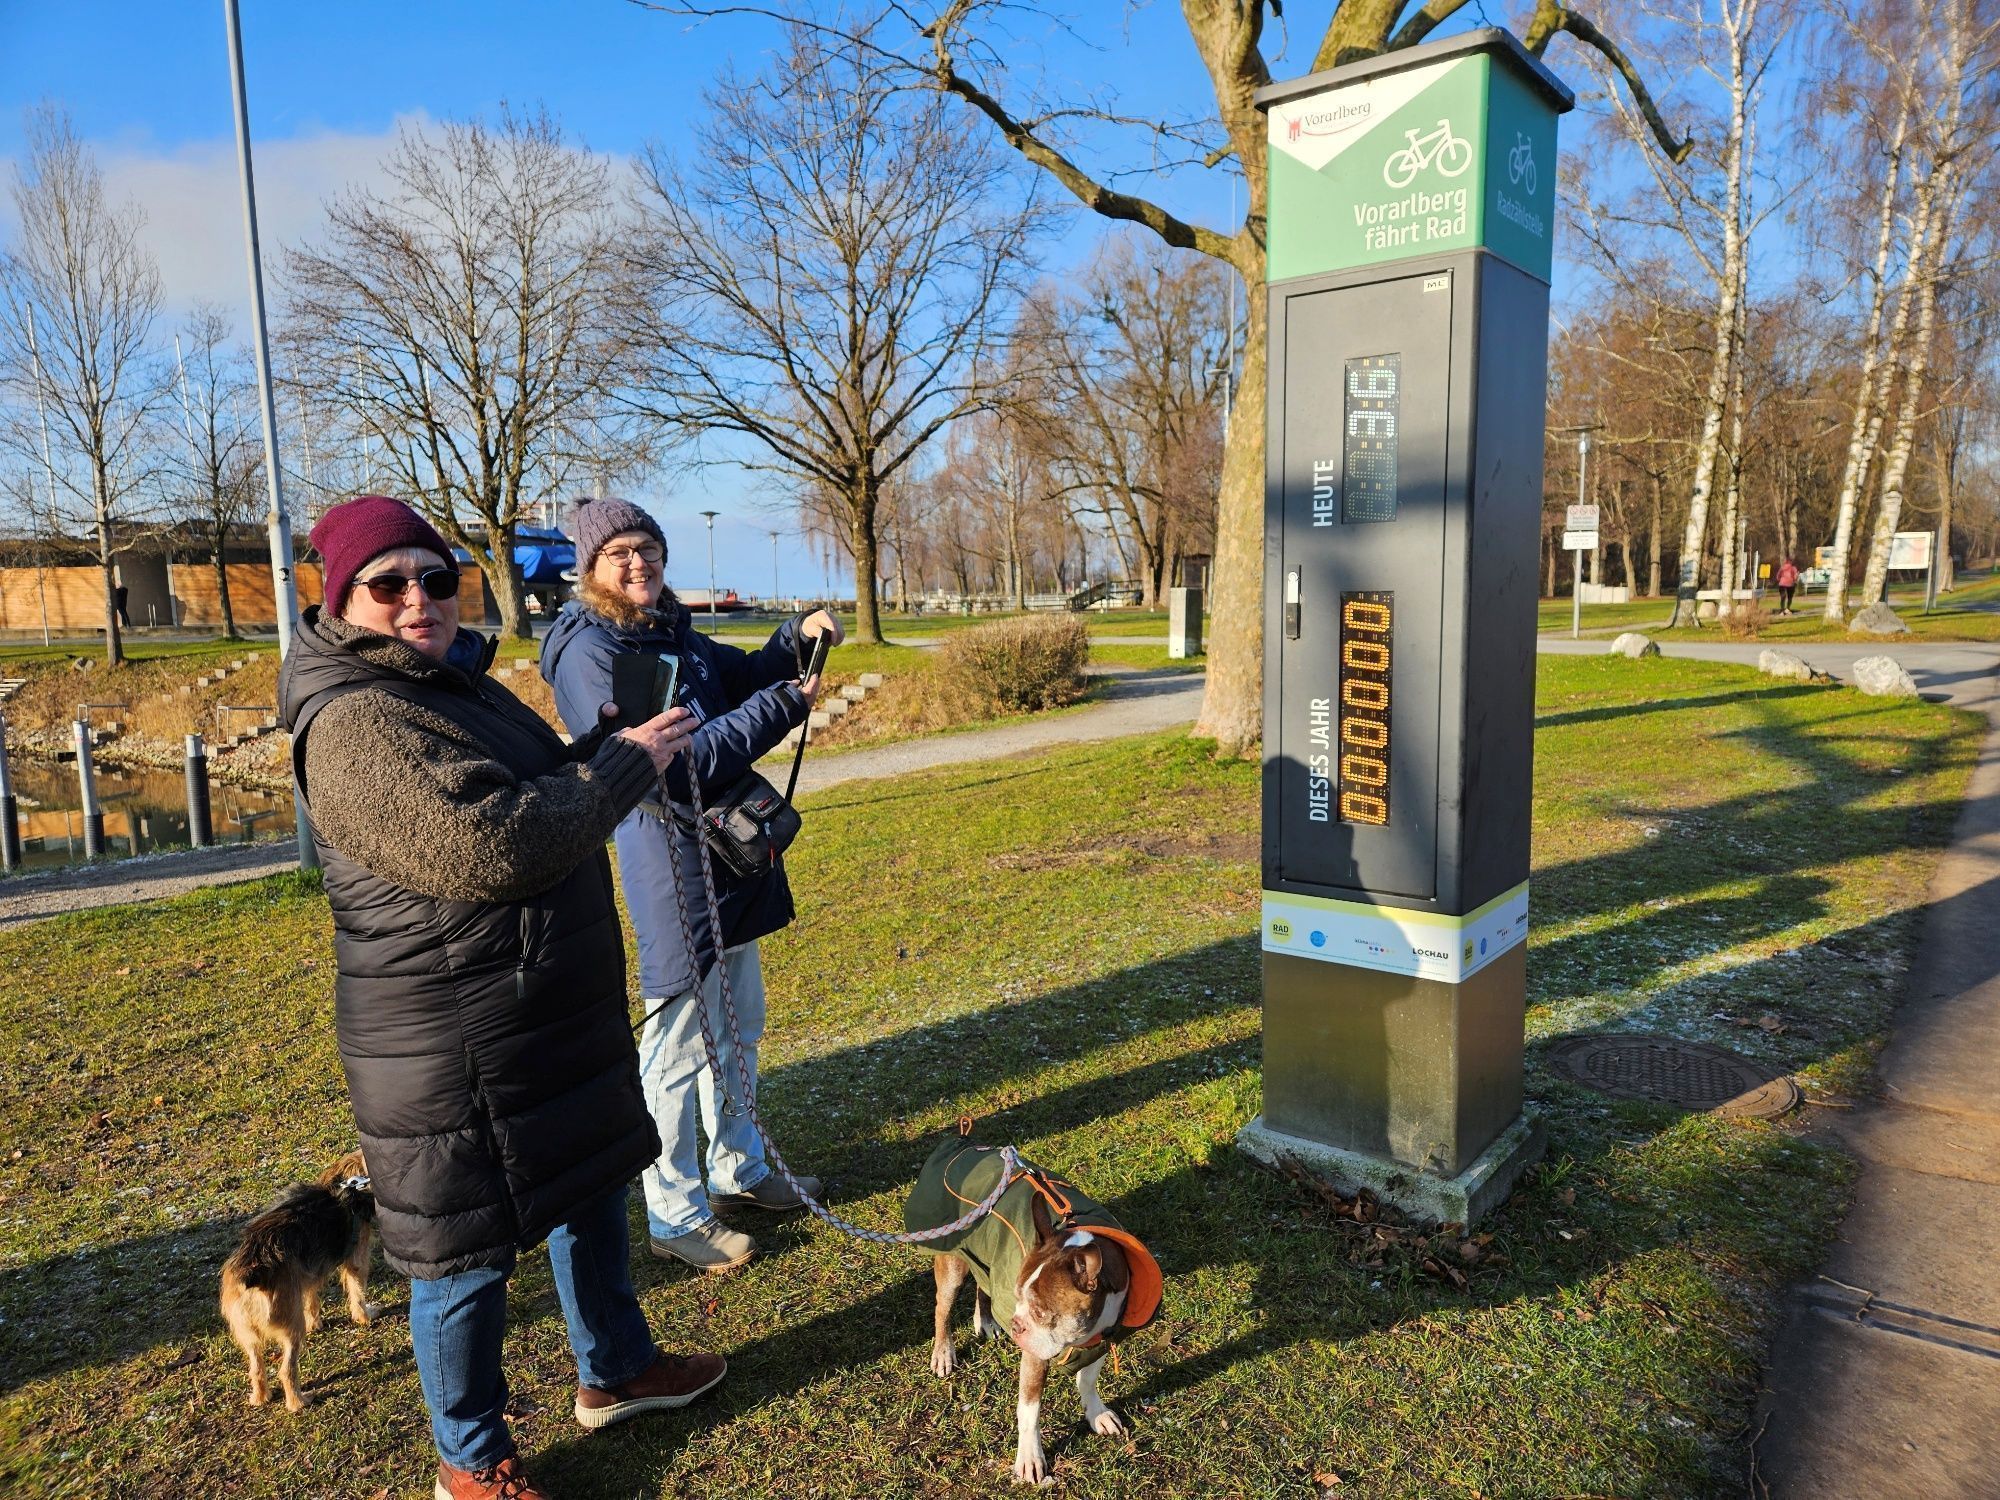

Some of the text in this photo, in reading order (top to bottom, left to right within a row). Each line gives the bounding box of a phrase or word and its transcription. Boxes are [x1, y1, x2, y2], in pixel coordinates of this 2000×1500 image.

[1304, 102, 1371, 127] Vorarlberg
[1354, 188, 1467, 226] Vorarlberg
[1365, 211, 1467, 251] fährt Rad
[1313, 459, 1334, 527] HEUTE
[1340, 600, 1391, 825] 000000
[1309, 697, 1330, 822] DIESES JAHR
[1272, 923, 1289, 934] RAD
[1412, 947, 1449, 960] LOCHAU
